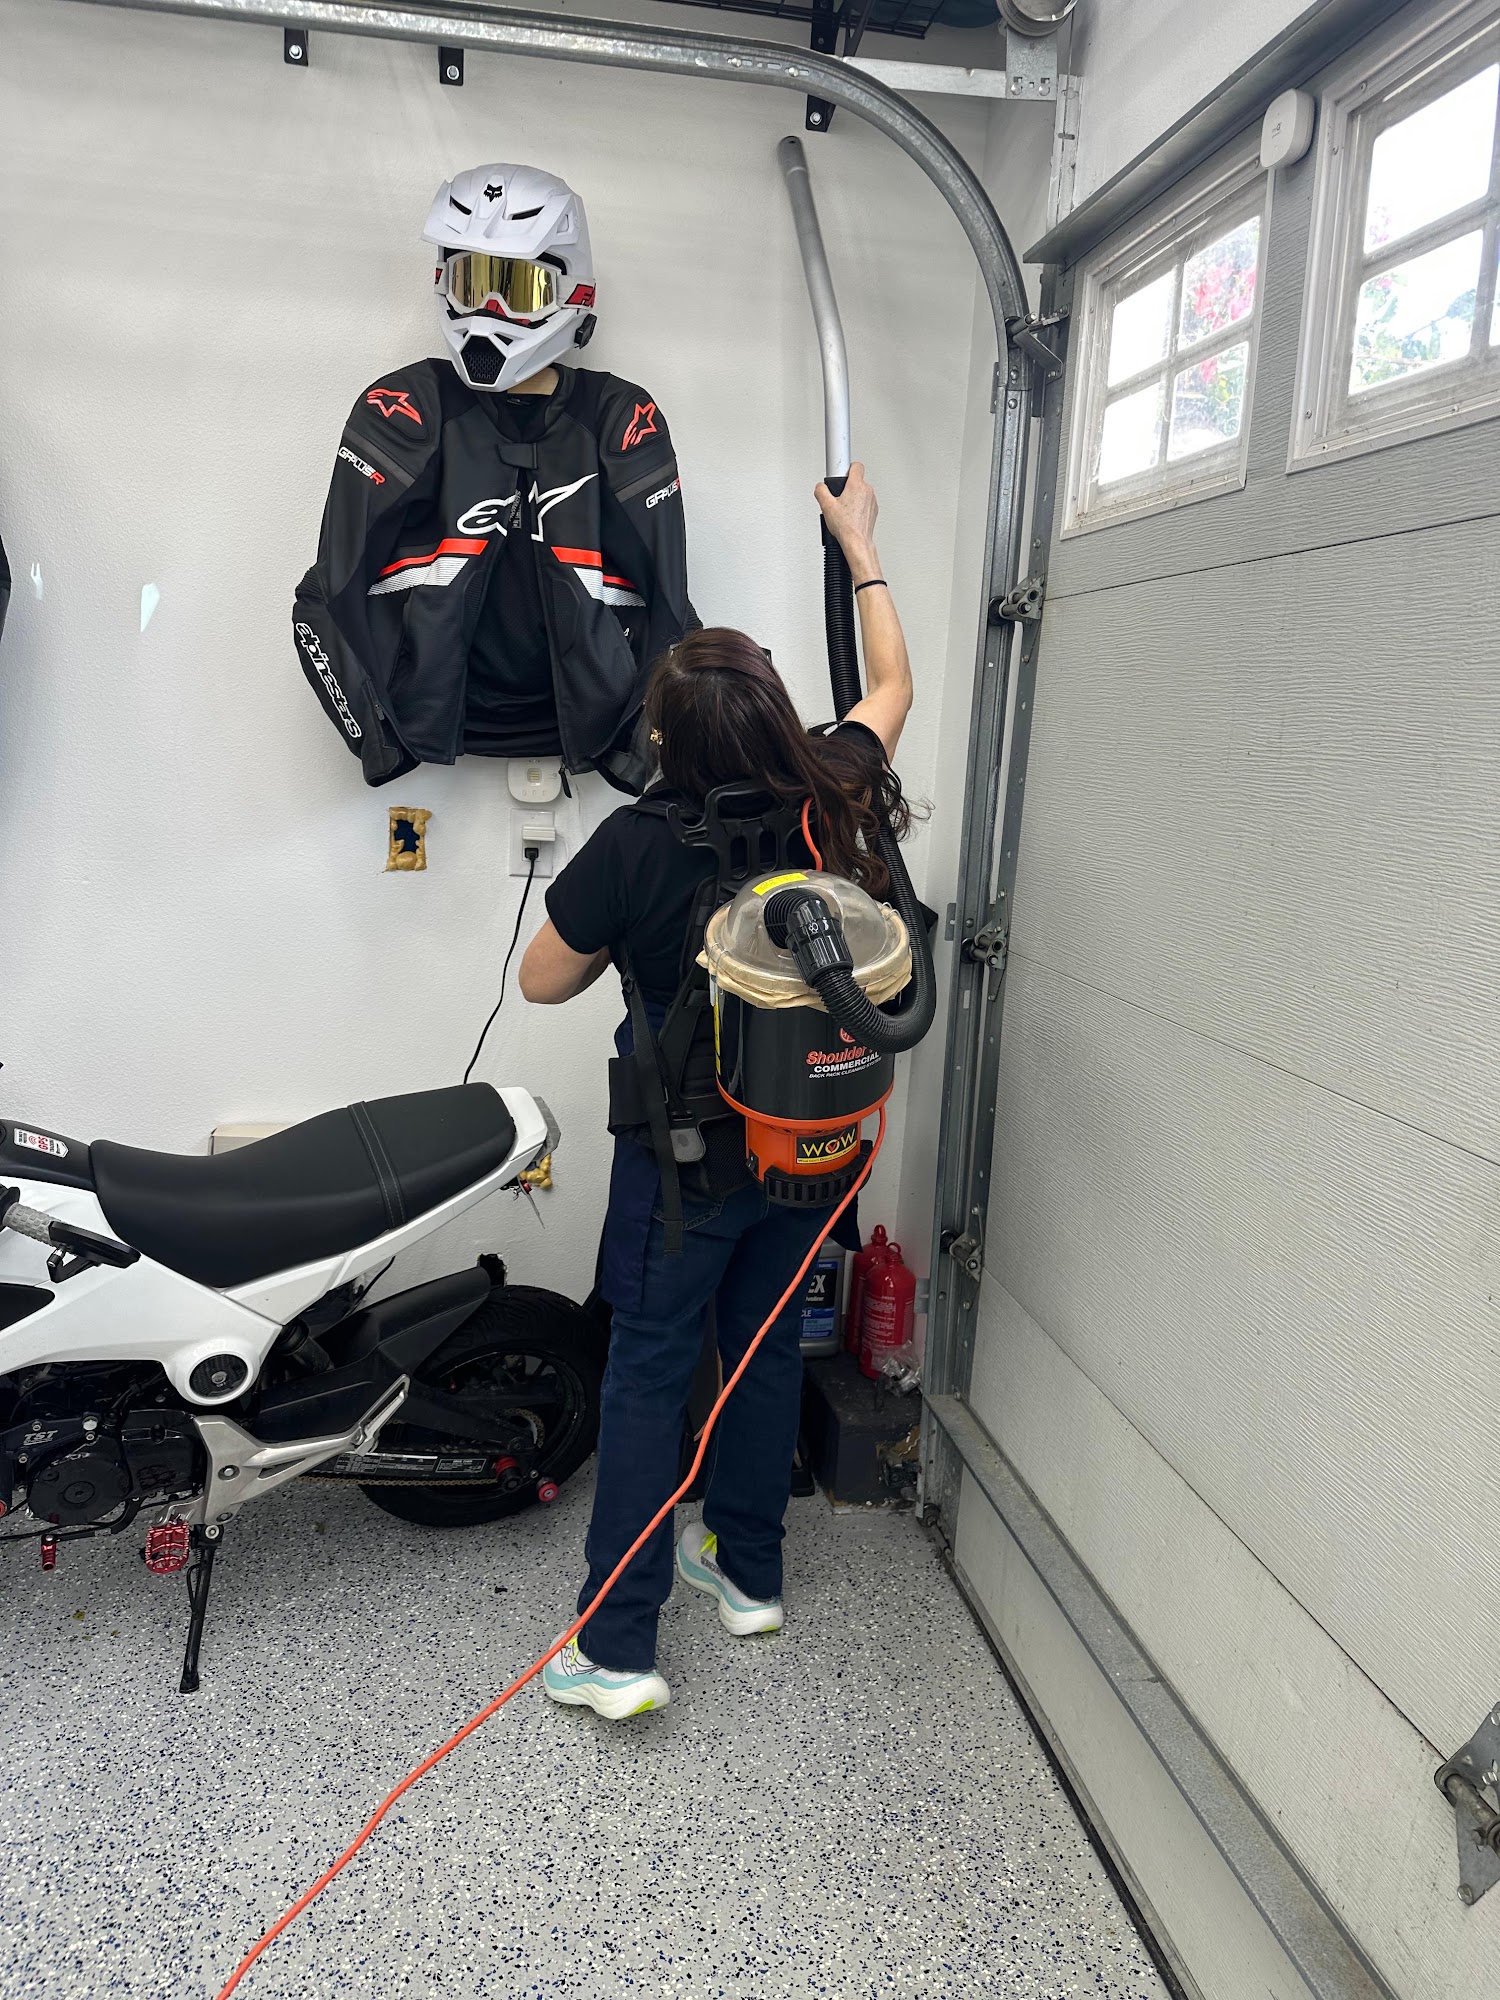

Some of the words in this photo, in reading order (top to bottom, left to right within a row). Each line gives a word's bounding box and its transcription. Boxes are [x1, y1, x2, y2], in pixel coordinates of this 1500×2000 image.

[296, 622, 362, 738] alpinestars
[806, 1046, 867, 1065] Shoulder
[814, 1051, 880, 1073] COMMERCIAL
[38, 1136, 49, 1150] GPS
[801, 1128, 856, 1157] WOW
[24, 1430, 58, 1444] TST
